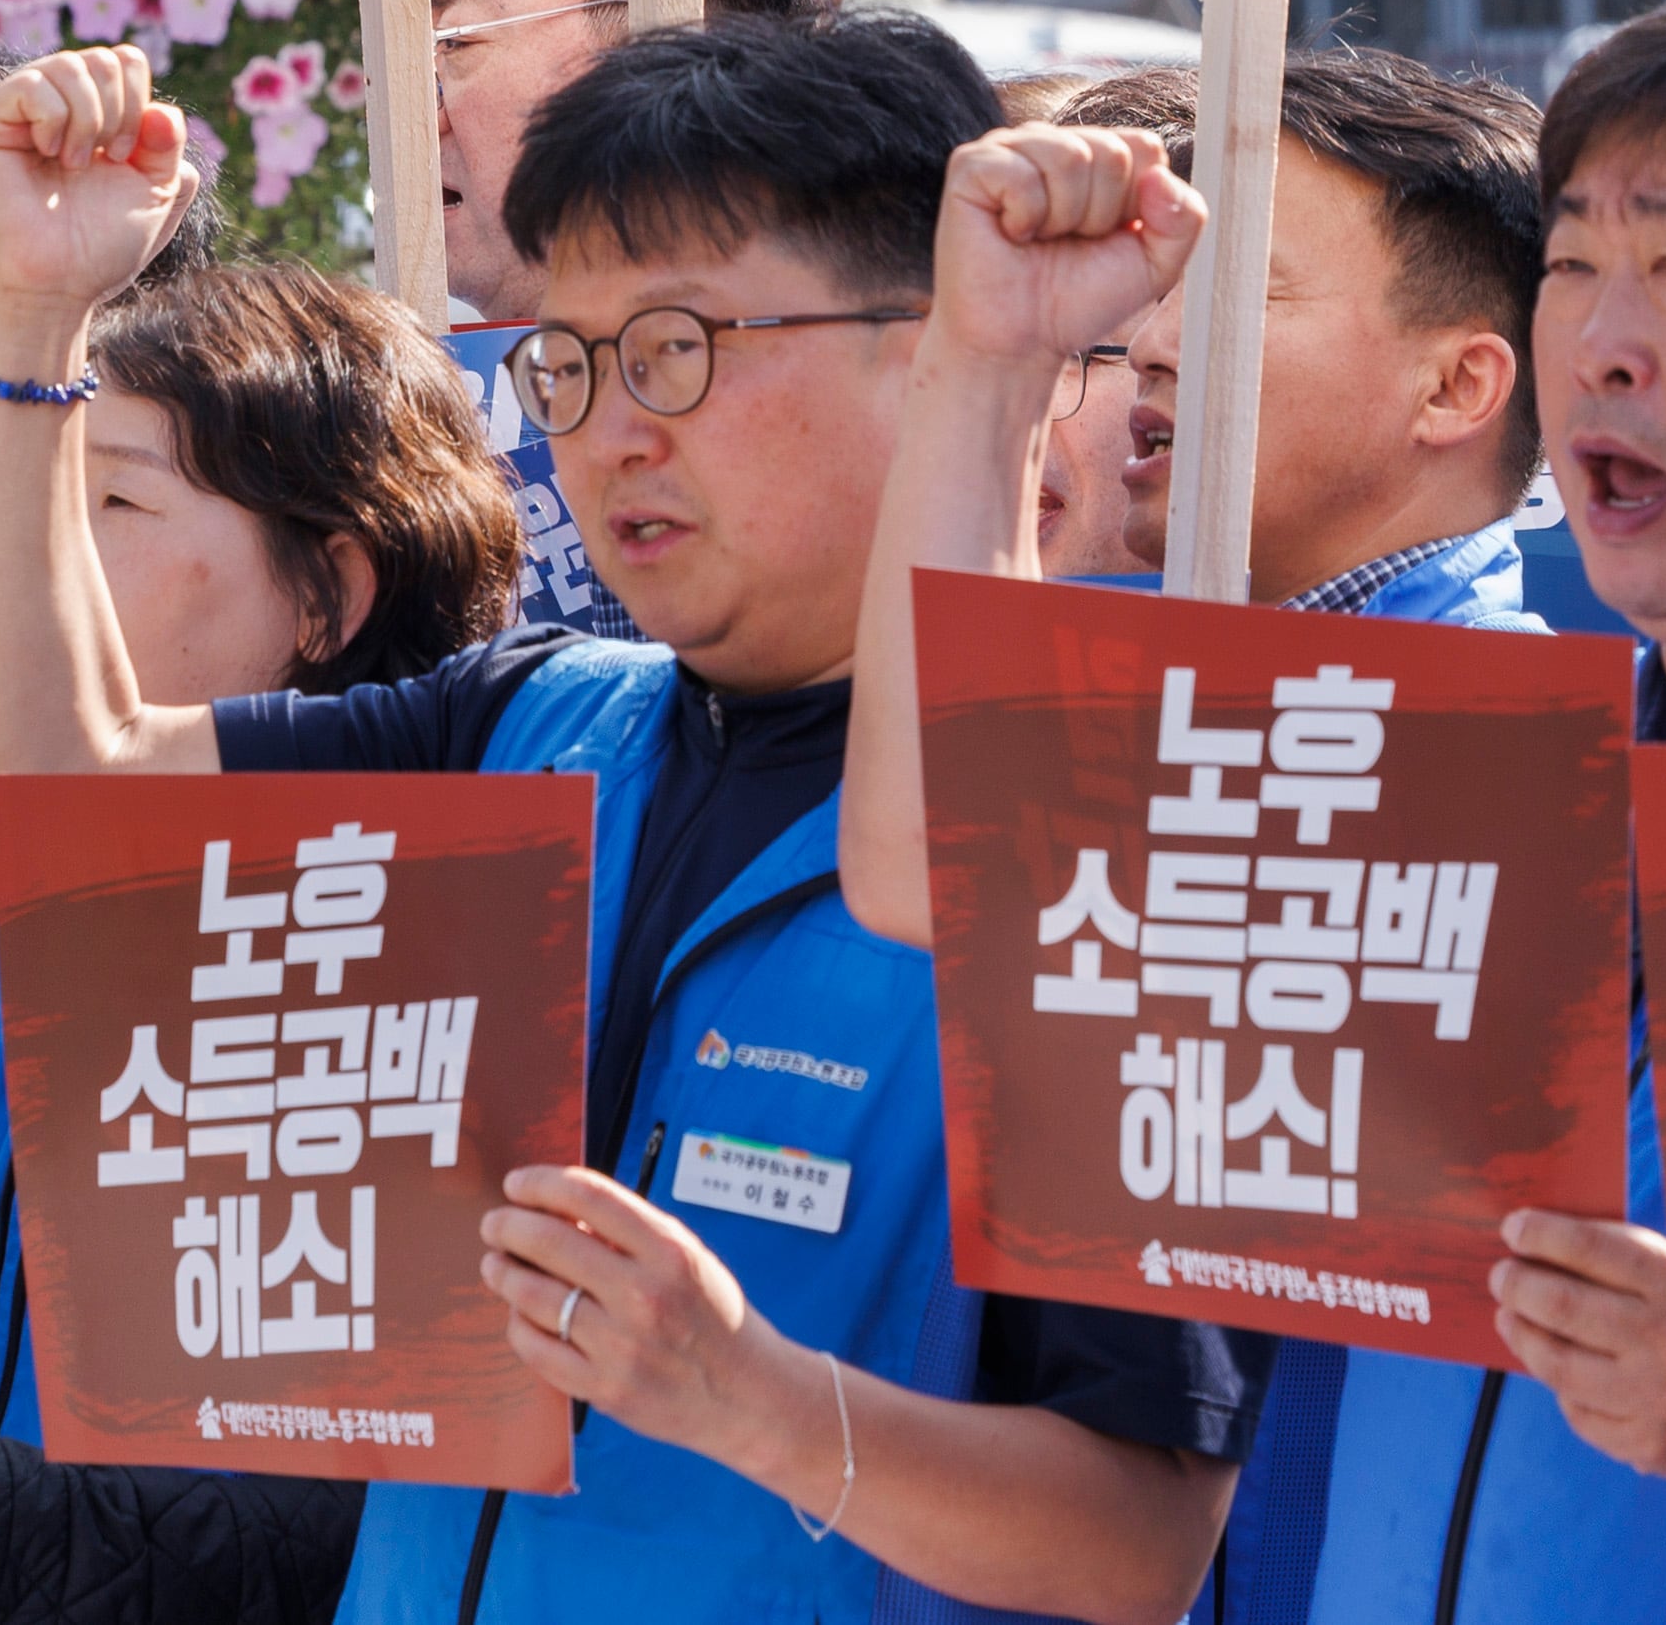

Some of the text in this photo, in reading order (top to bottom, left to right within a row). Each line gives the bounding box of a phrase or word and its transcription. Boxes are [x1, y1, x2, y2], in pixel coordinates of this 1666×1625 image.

[1148, 665, 1395, 844] 노후
[191, 822, 396, 1002] 노후
[1033, 849, 1498, 1041] 소득공백
[97, 996, 478, 1187] 소득공백
[1120, 1034, 1363, 1219] 해소!
[172, 1186, 375, 1358] 해소!
[221, 1402, 434, 1447] 대한민국공무원노동조합총연맹
